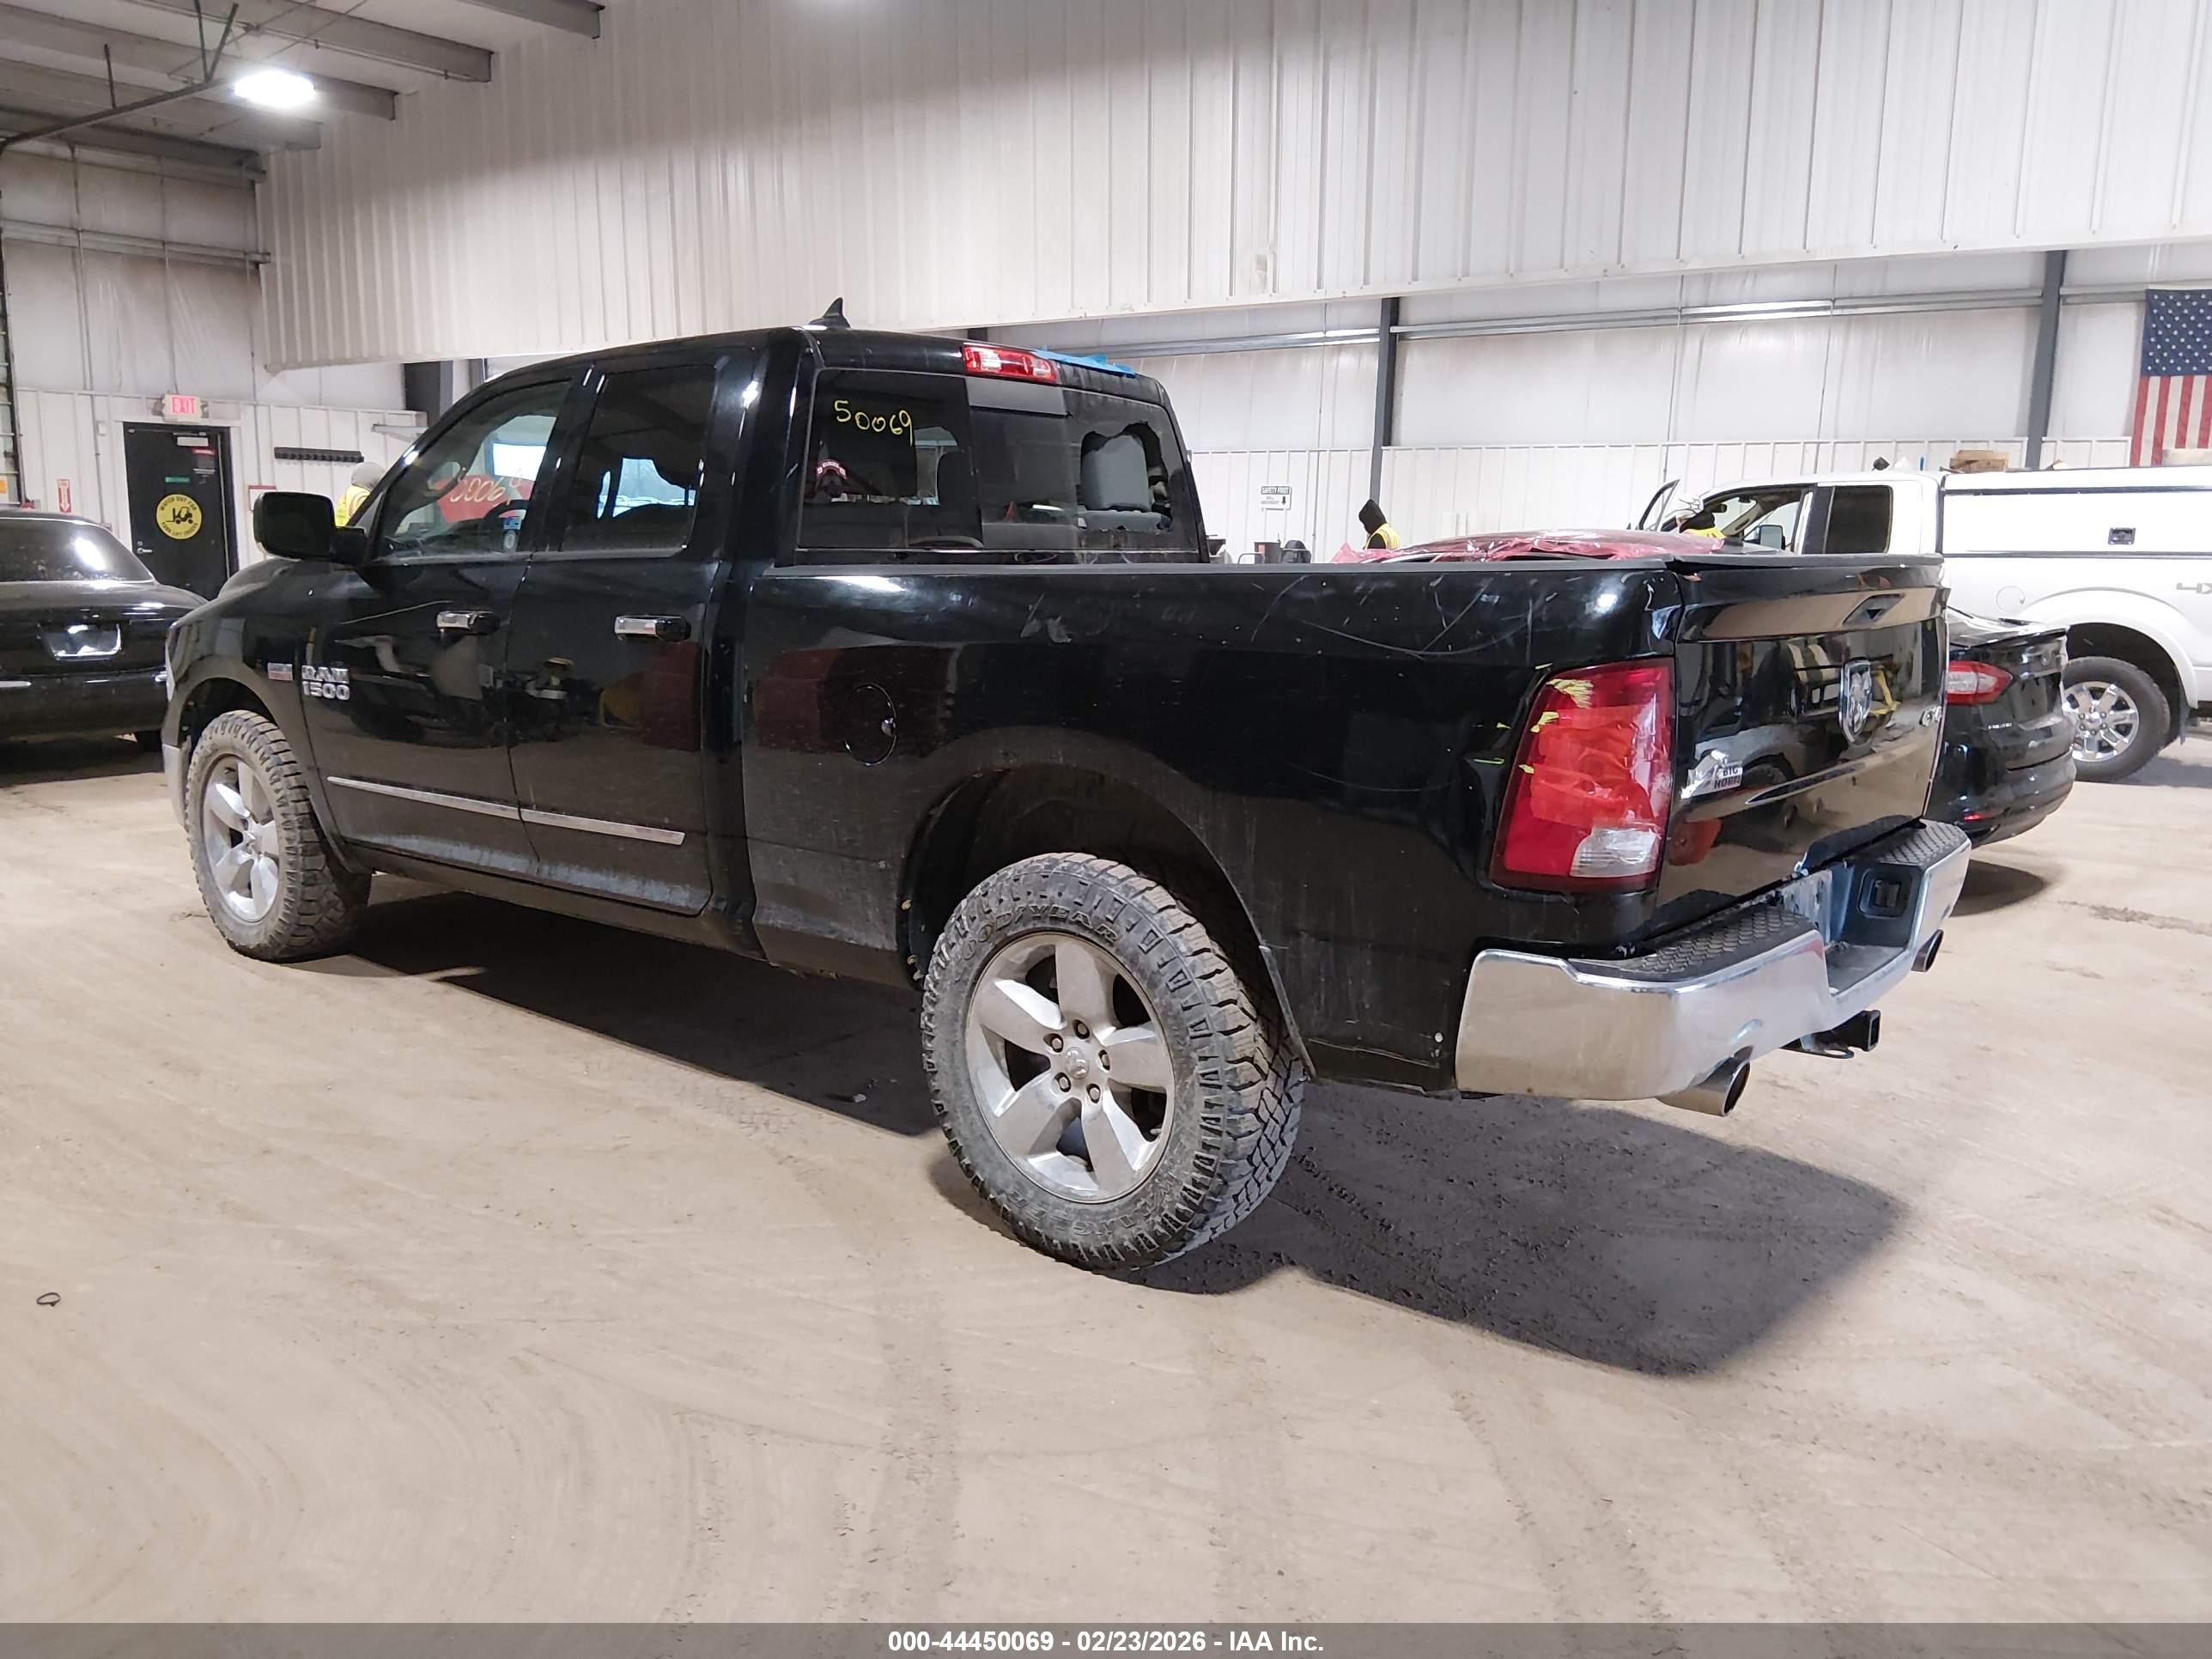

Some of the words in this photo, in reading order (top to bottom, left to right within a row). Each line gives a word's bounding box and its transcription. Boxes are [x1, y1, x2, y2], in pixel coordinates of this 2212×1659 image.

[172, 397, 196, 414] EXIT
[834, 399, 914, 447] 50069
[301, 665, 349, 684] RAM
[302, 680, 350, 701] 1500
[1723, 764, 1739, 776] BIG
